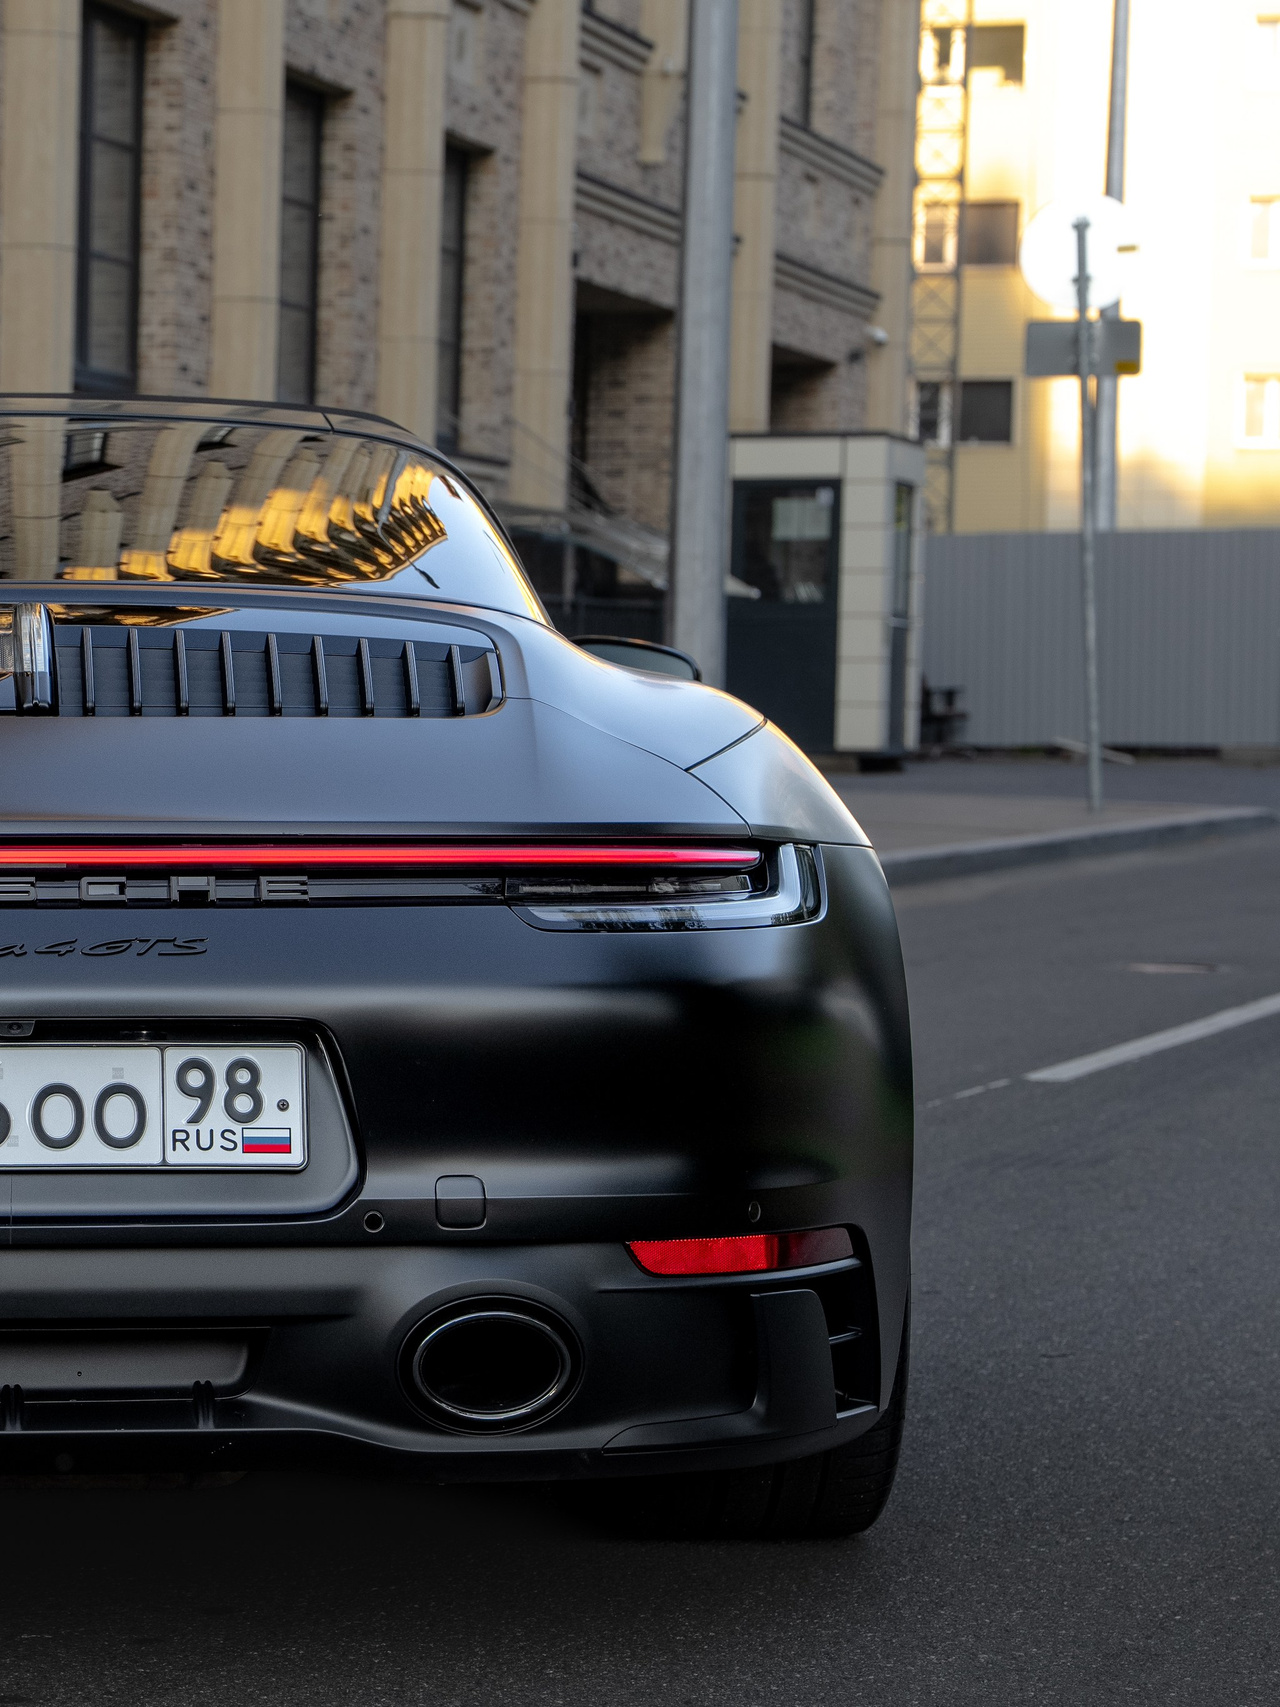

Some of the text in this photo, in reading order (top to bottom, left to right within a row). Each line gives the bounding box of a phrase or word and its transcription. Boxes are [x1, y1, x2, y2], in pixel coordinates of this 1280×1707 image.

[34, 938, 78, 956] 4
[80, 936, 209, 957] GTS
[175, 1057, 255, 1124] 98
[172, 1129, 238, 1151] RUS
